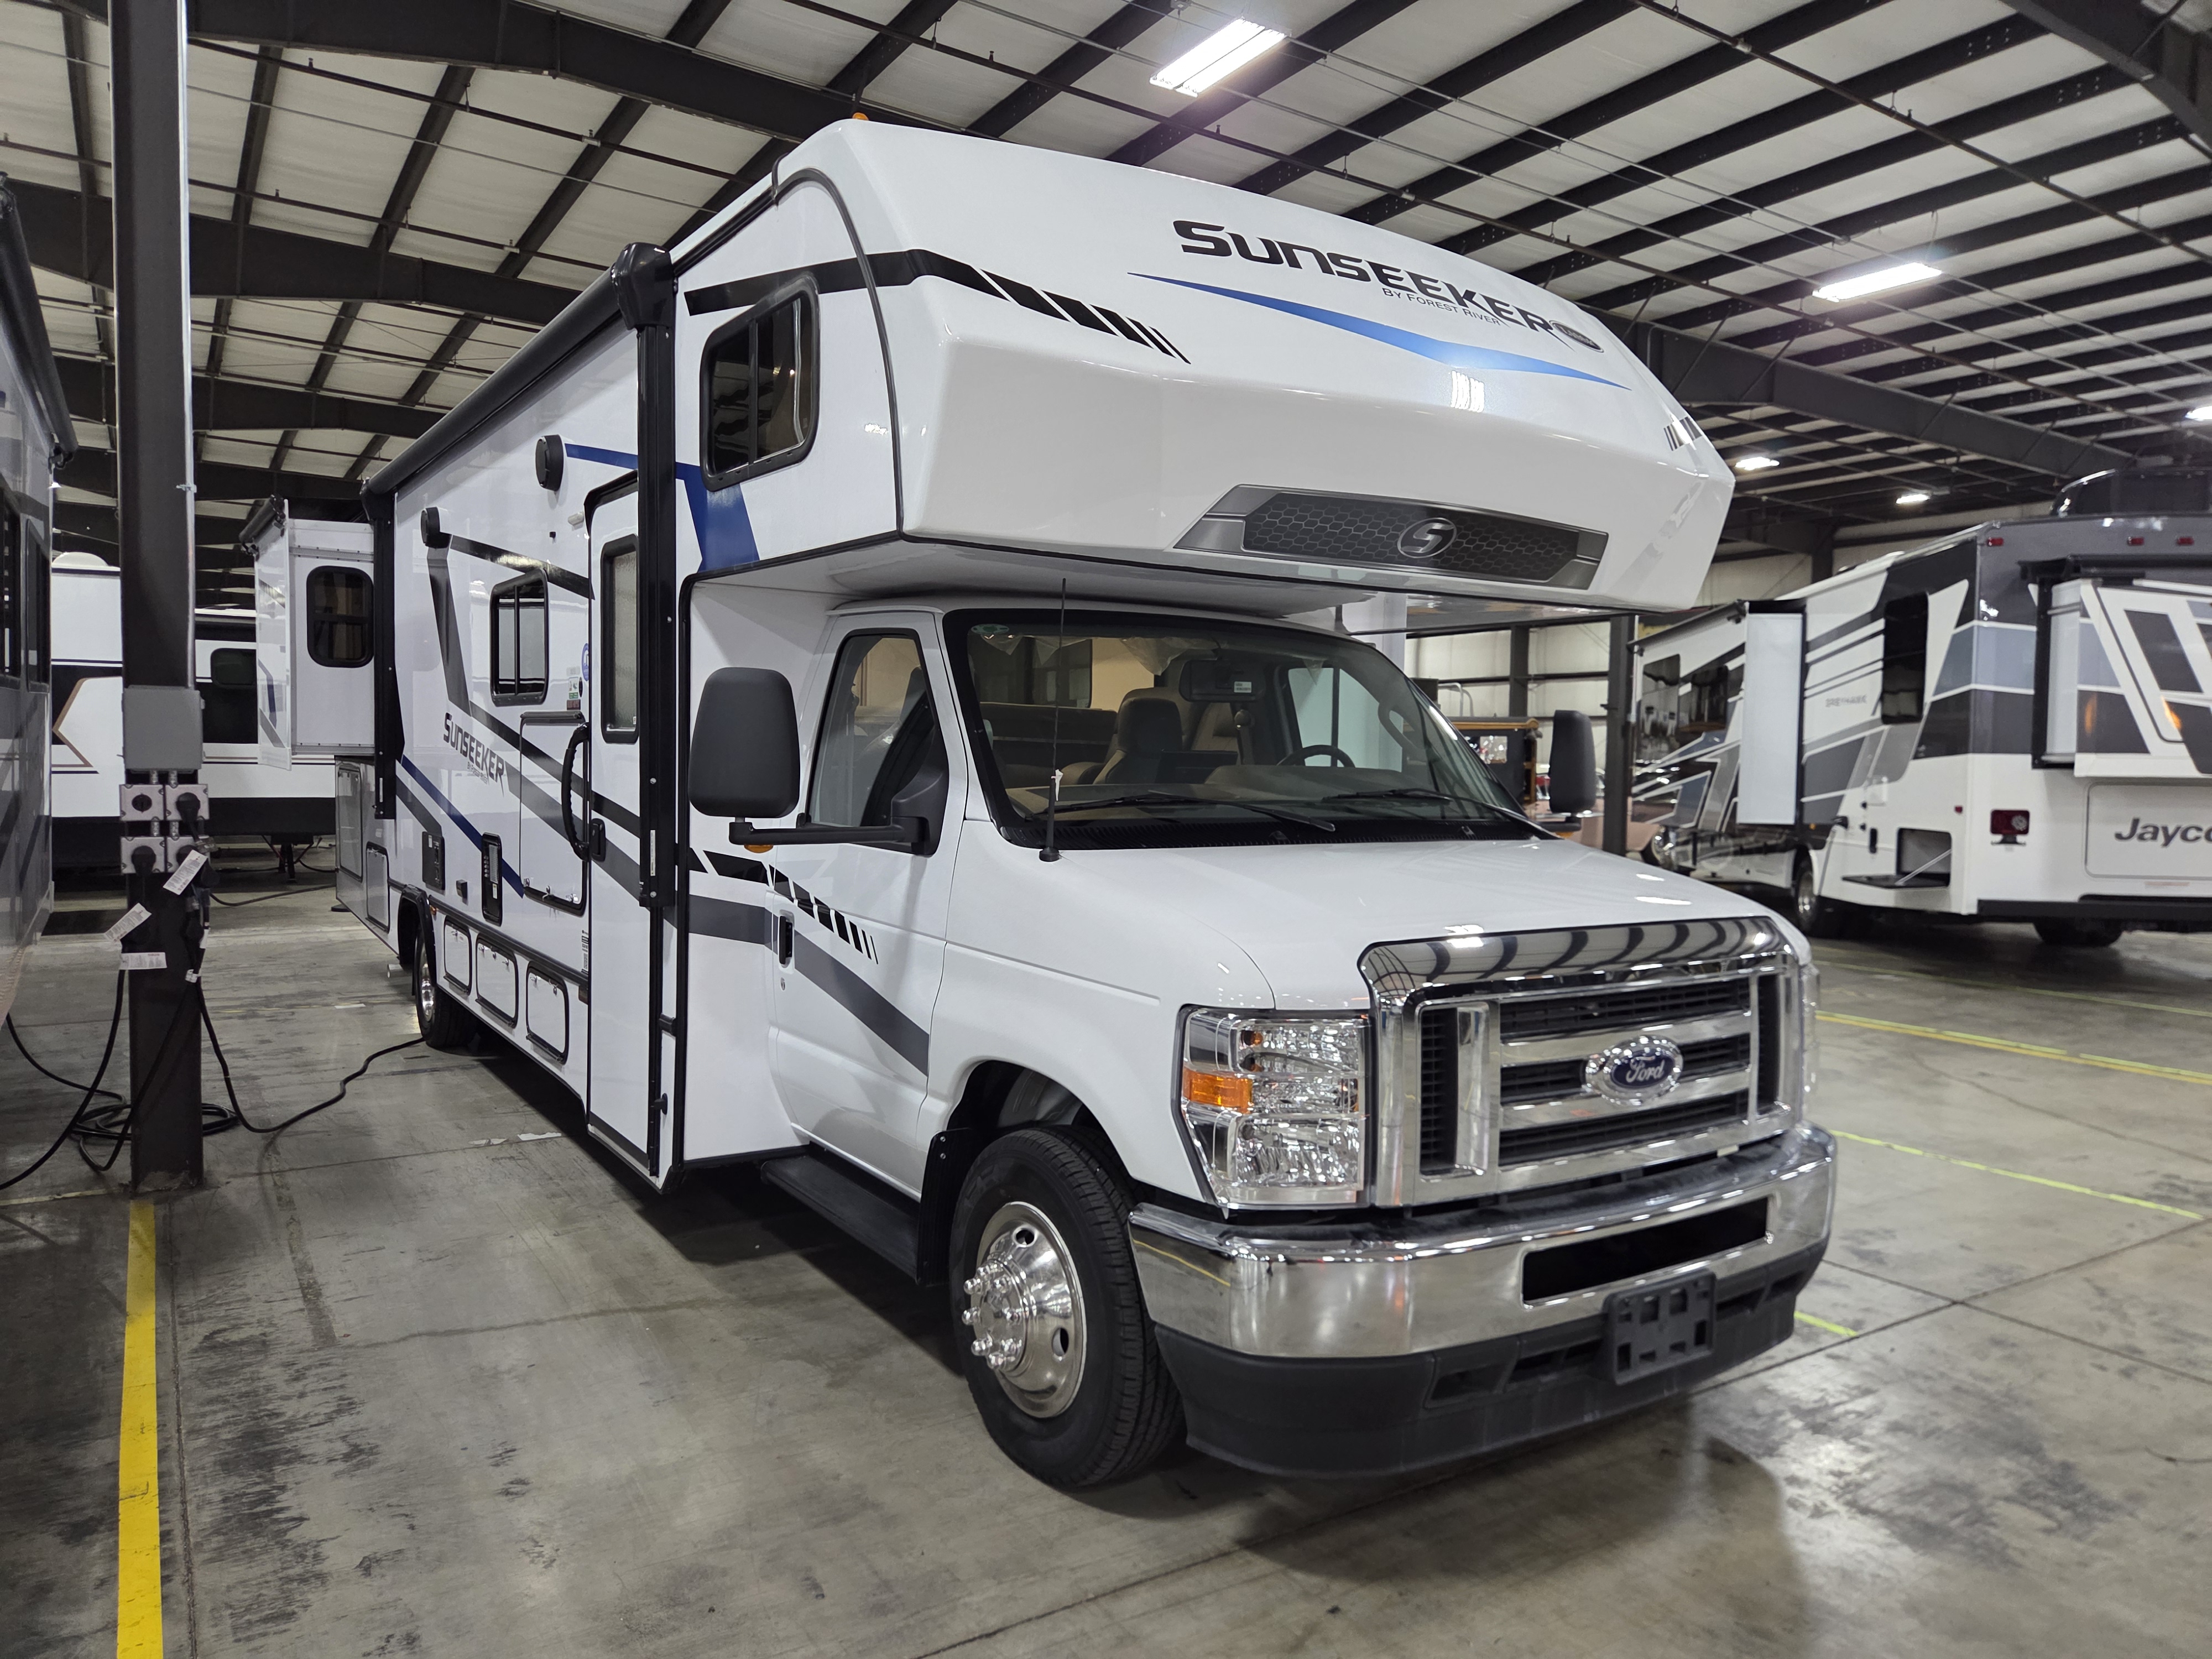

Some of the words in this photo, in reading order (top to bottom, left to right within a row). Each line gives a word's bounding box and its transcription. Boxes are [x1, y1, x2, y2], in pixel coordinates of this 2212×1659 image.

[1382, 288, 1401, 299] BY
[1406, 293, 1458, 314] FOREST
[1463, 307, 1501, 326] RIVER
[1626, 1057, 1665, 1082] Ford
